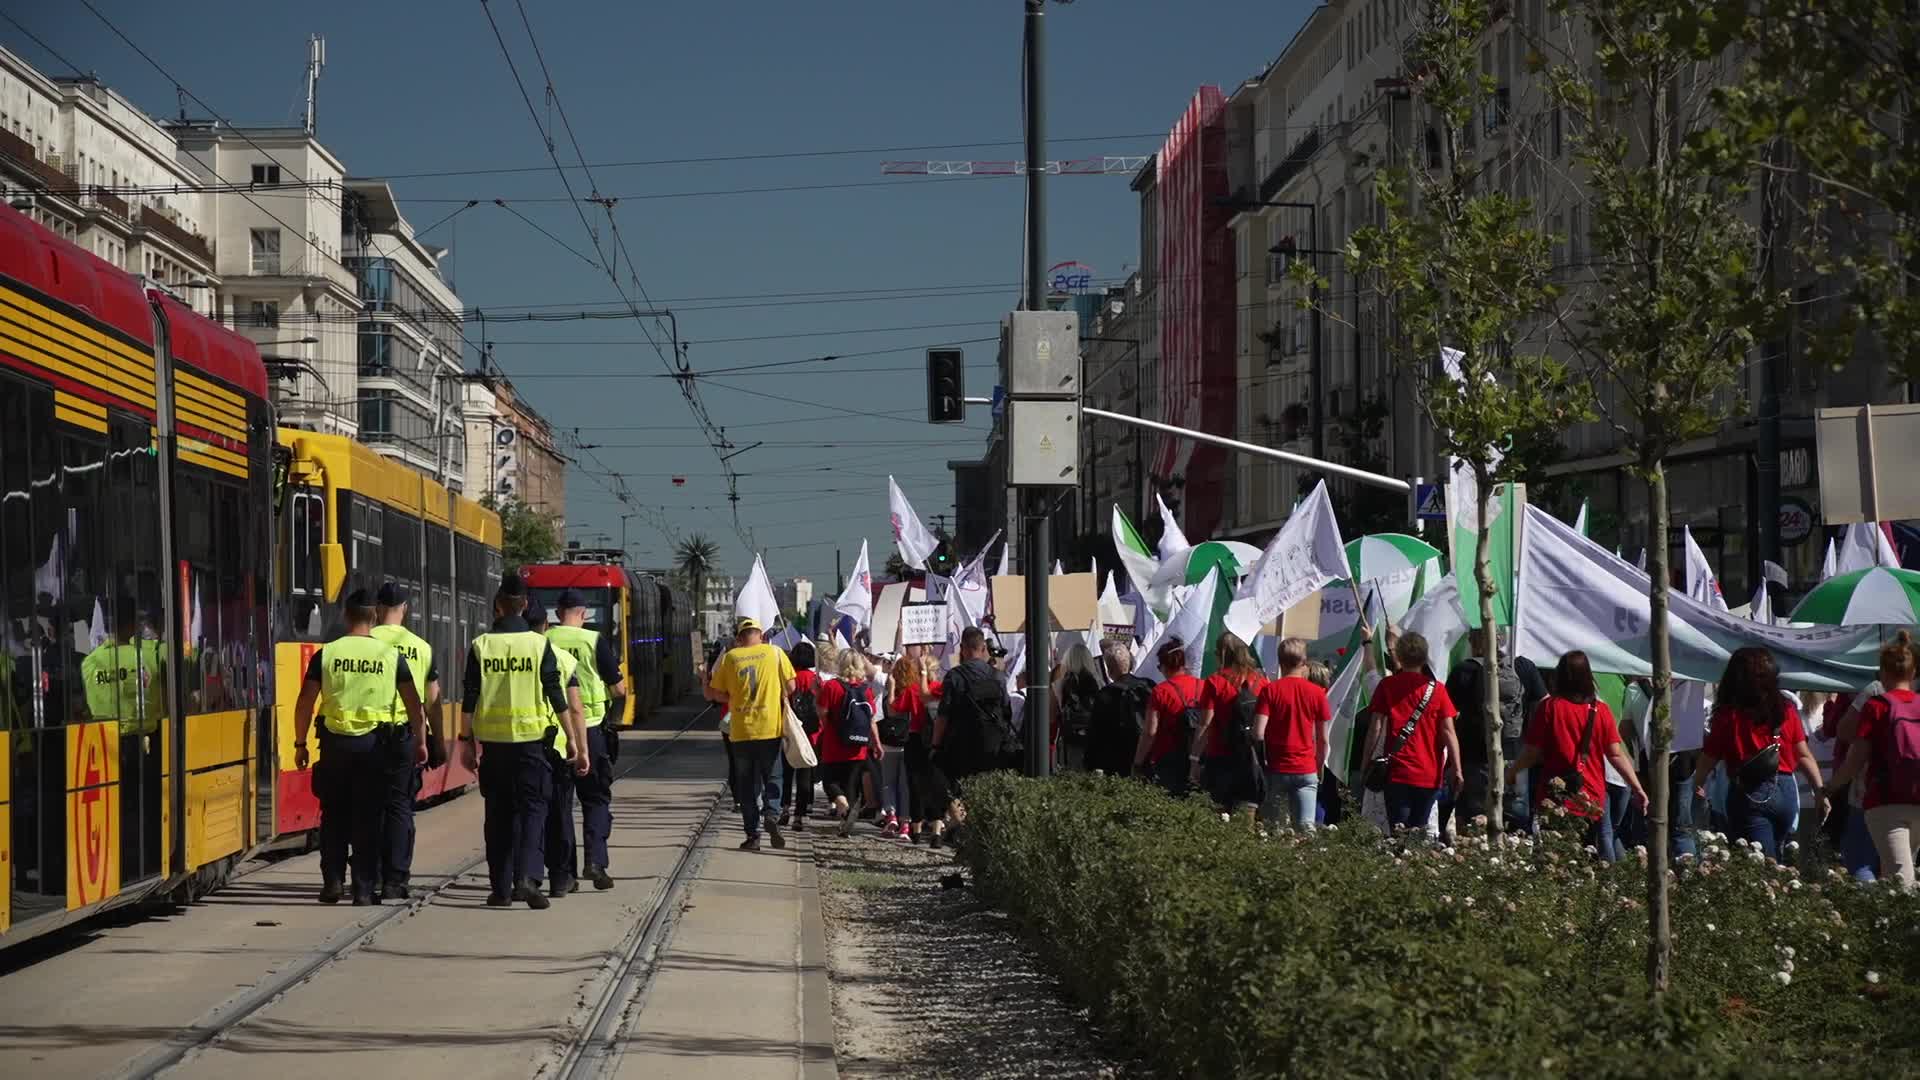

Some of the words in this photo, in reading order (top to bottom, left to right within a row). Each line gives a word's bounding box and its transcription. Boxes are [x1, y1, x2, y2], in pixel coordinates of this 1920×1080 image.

[1053, 275, 1091, 289] PGE
[334, 658, 383, 675] POLICJA
[484, 656, 532, 673] POLICJA
